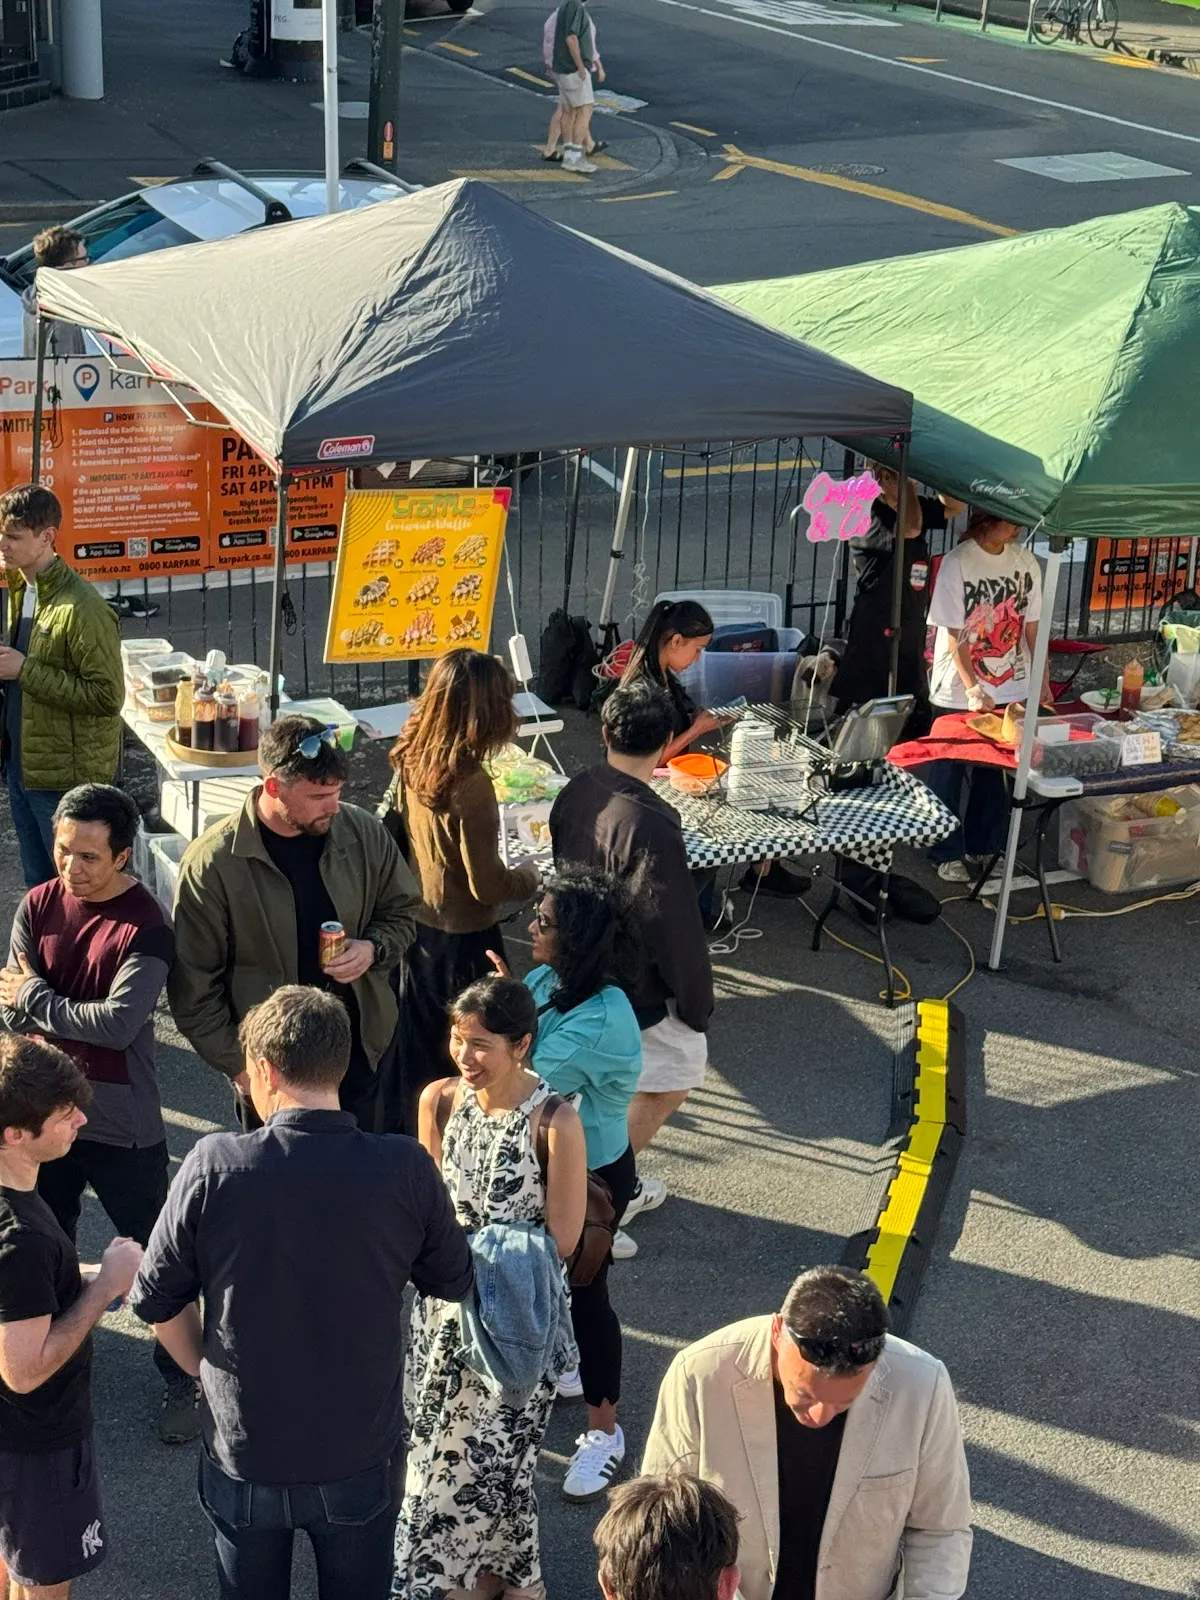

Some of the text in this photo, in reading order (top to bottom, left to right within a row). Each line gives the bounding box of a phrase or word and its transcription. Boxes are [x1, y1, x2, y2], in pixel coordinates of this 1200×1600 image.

[116, 412, 134, 421] HOW
[222, 464, 244, 480] FRI
[220, 482, 246, 497] SAT
[285, 549, 300, 559] 800
[162, 558, 201, 570] KARPARK
